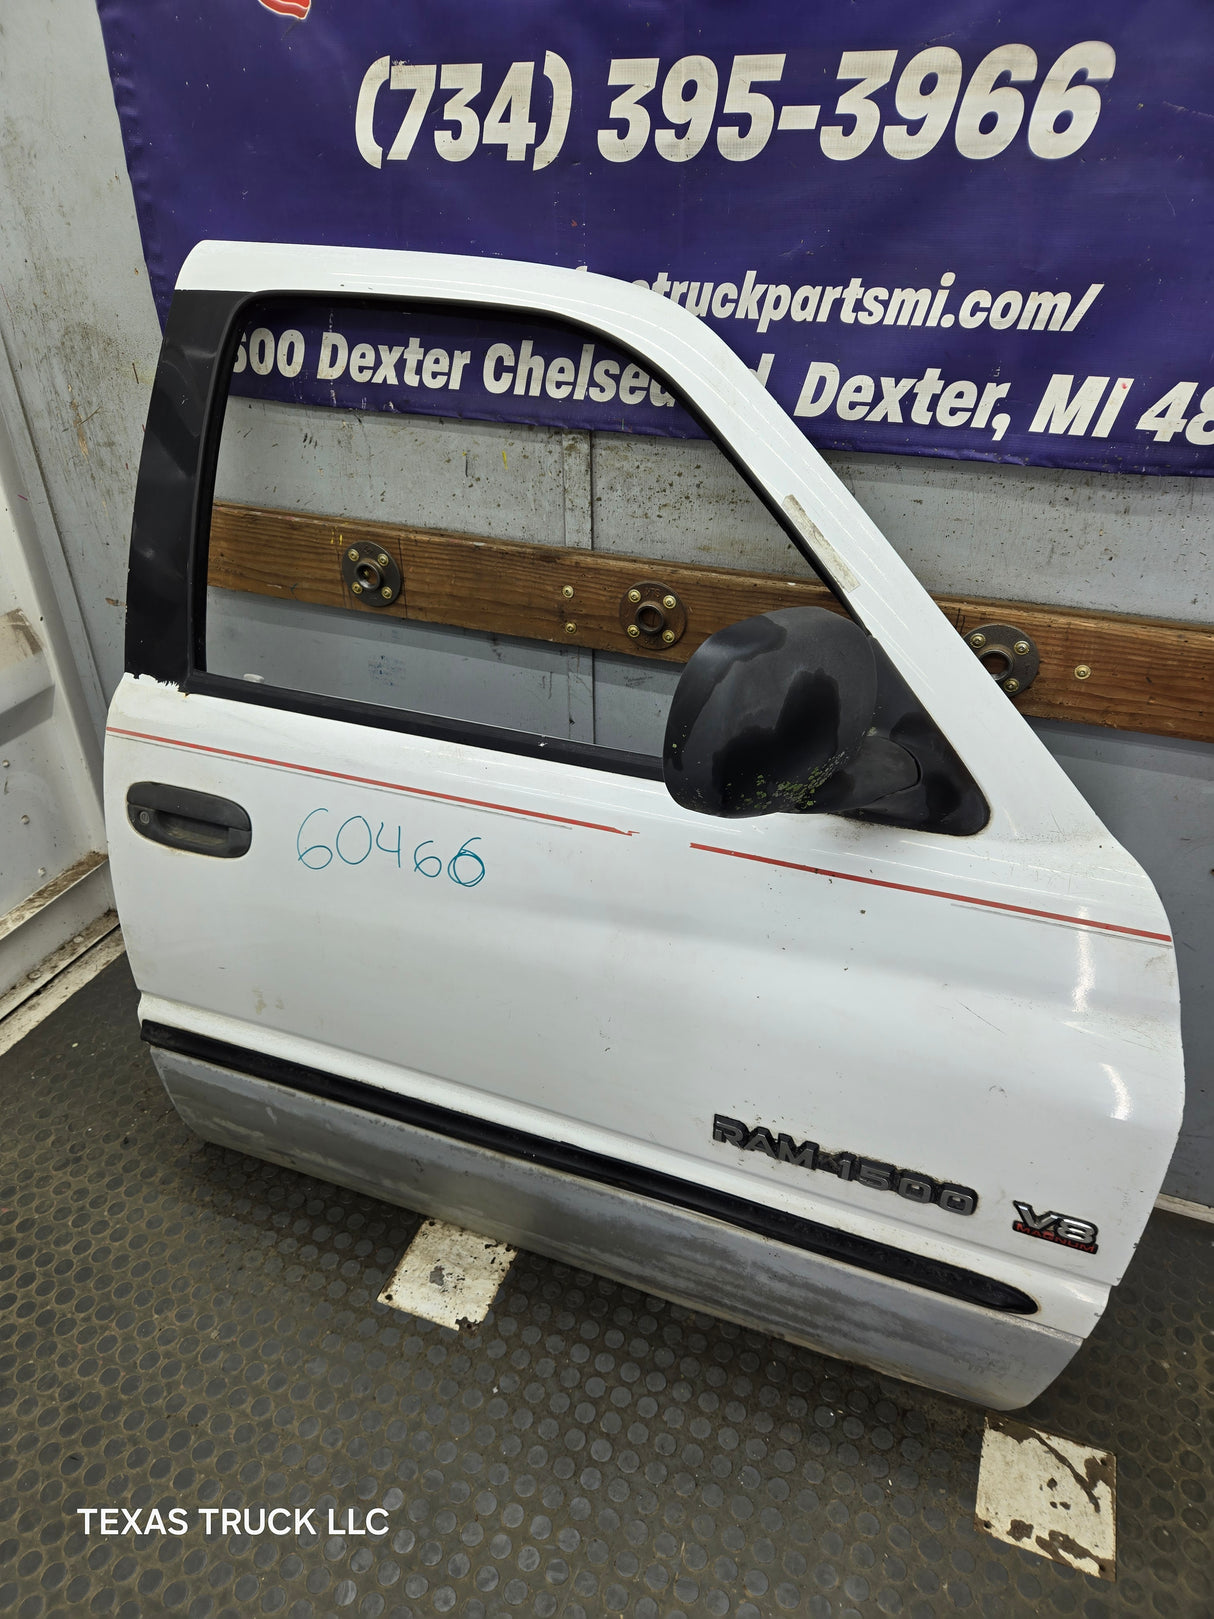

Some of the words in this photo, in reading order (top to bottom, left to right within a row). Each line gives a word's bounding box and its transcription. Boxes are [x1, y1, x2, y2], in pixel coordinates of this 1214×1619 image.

[355, 50, 573, 171] (734)
[597, 40, 1116, 163] 395-3966
[631, 270, 1105, 333] truckpartsmi.com/
[317, 332, 471, 390] Dexter
[793, 361, 1011, 441] Dexter,
[1028, 374, 1135, 438] MI
[297, 808, 485, 887] 60466
[713, 1114, 819, 1170] RAM
[836, 1152, 979, 1216] 1500
[1012, 1200, 1098, 1244] V8
[1013, 1221, 1097, 1254] MAGNUM
